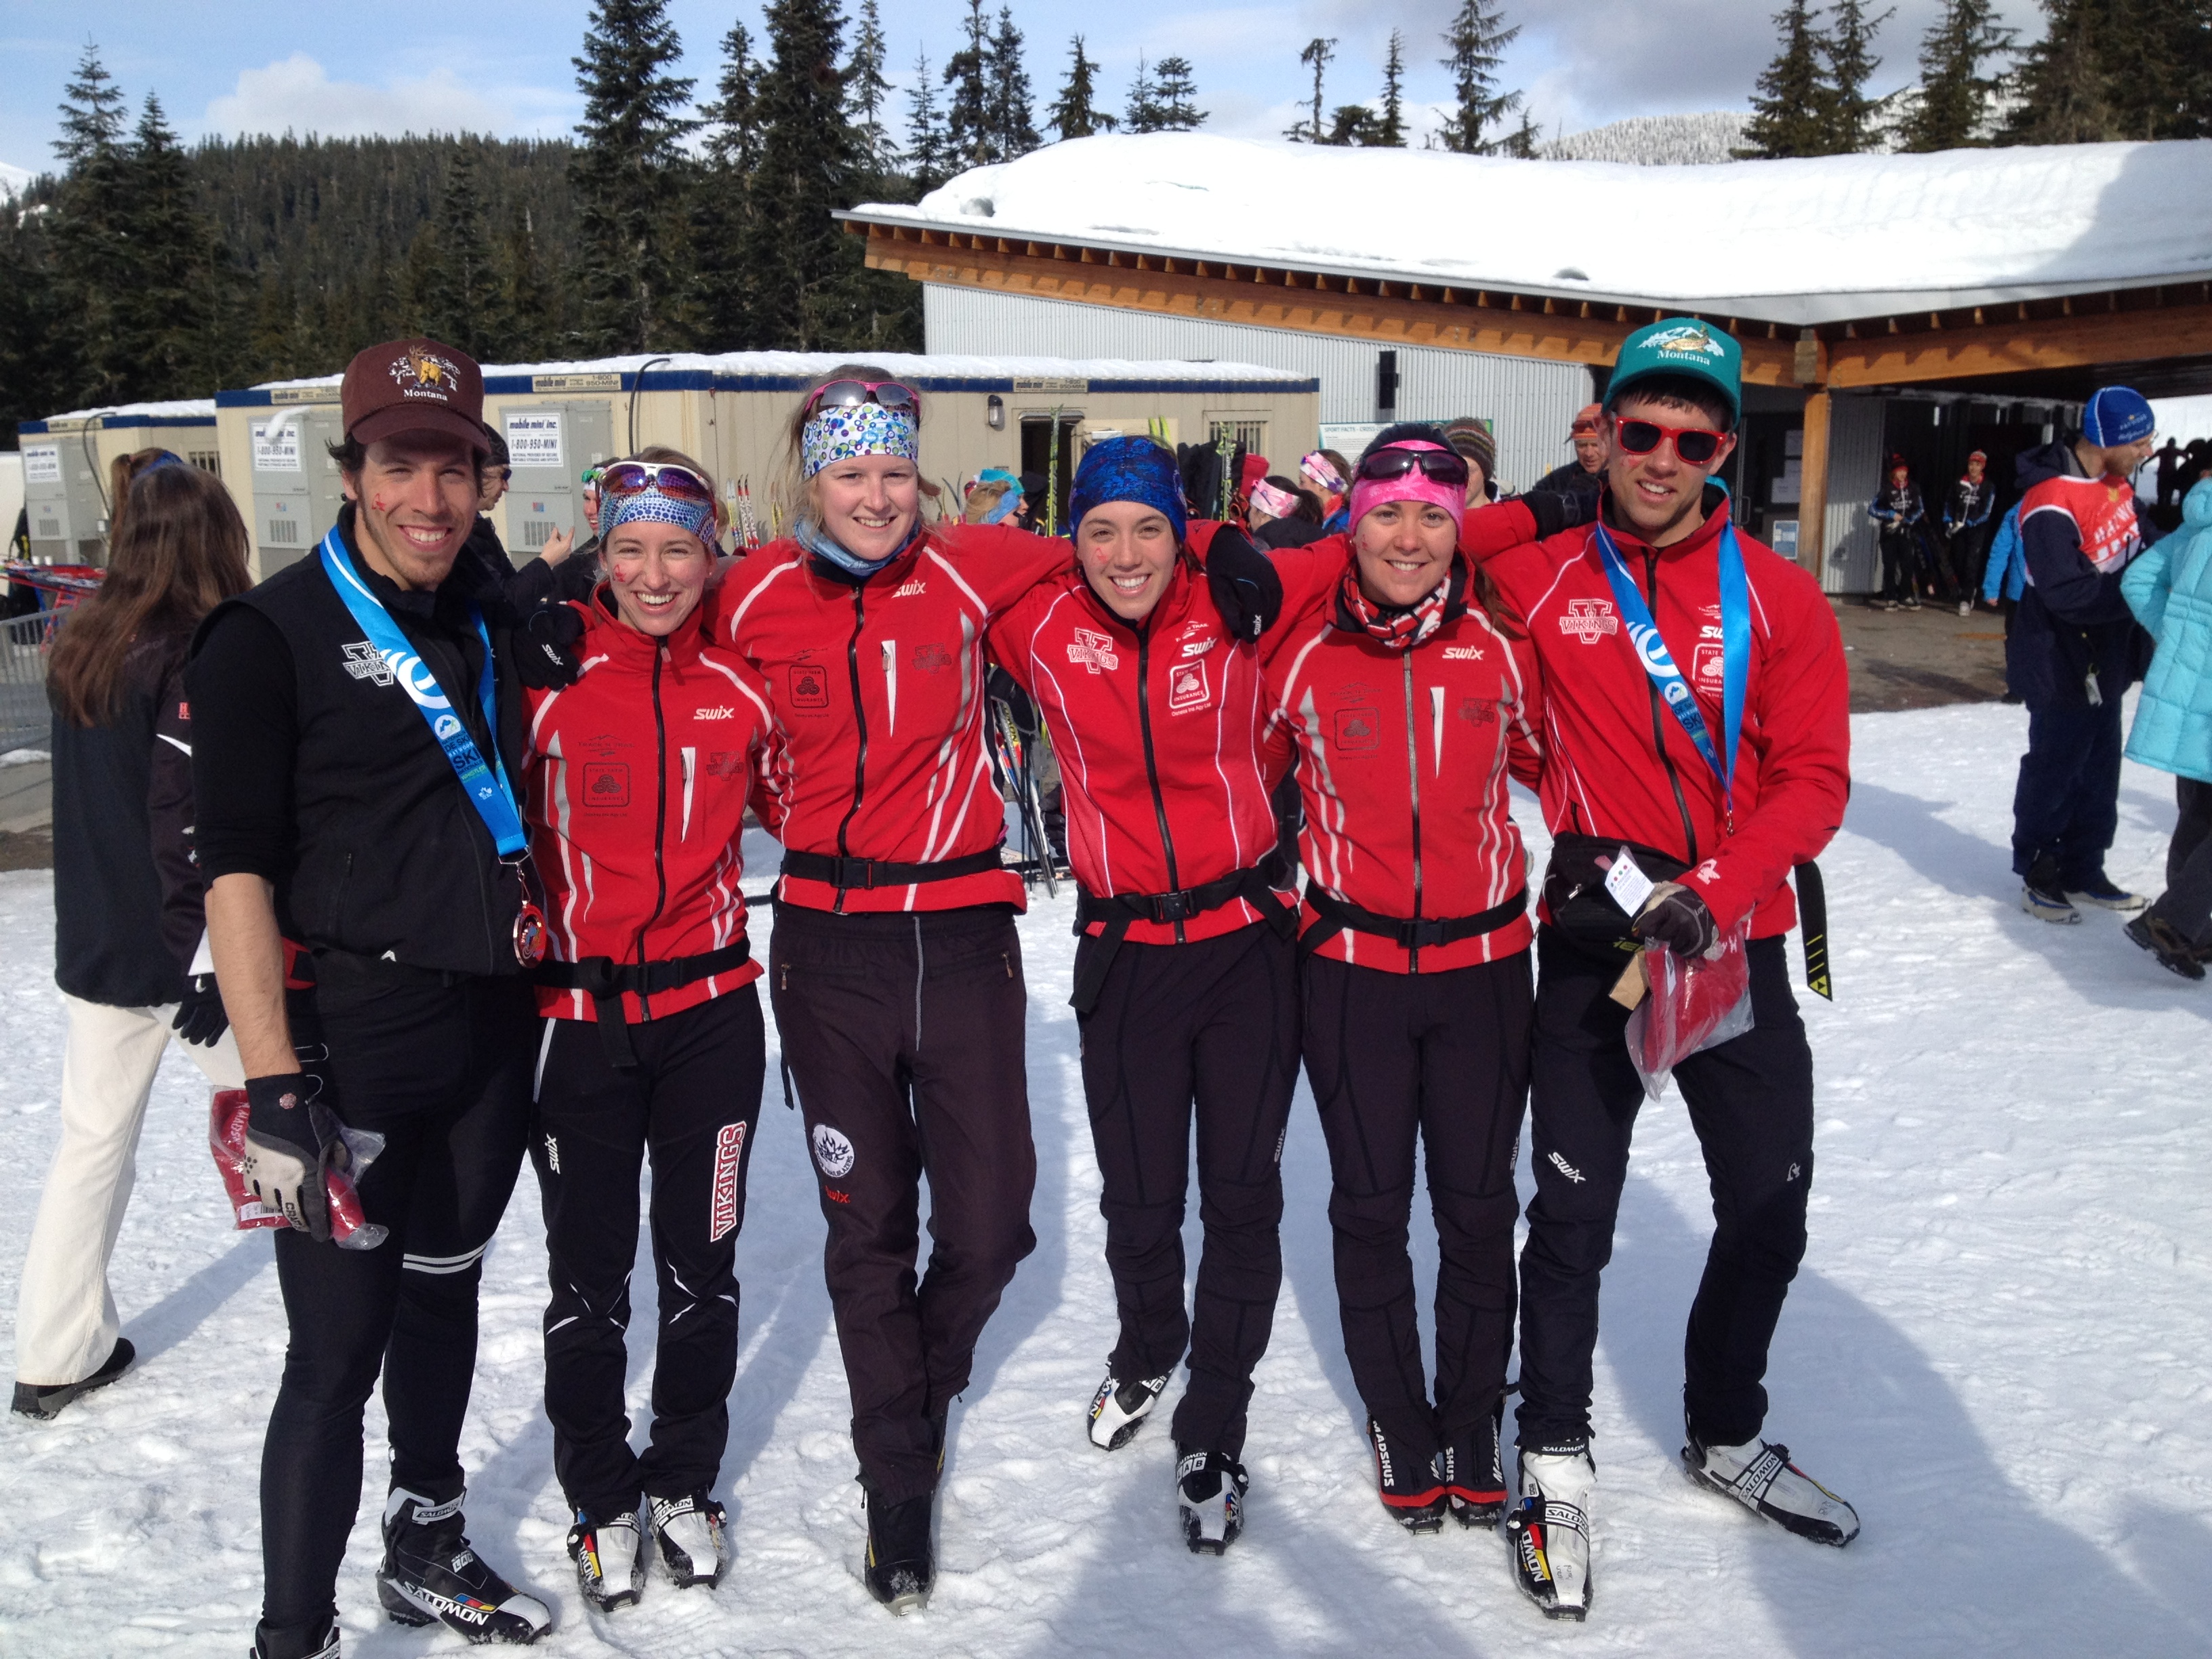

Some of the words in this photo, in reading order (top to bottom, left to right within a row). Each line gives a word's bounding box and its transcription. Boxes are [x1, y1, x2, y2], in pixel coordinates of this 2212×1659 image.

[1656, 350, 1711, 366] Montana
[403, 389, 448, 402] Montana
[511, 438, 558, 450] 1-800-950-MINI
[1561, 617, 1618, 634] VIKINGS
[346, 659, 392, 678] VIKIN
[1069, 645, 1118, 670] VIKINGS
[445, 741, 456, 752] DE
[452, 747, 482, 770] SKI
[824, 1155, 853, 1176] TRAILBLAZERS
[713, 1123, 745, 1240] VIKINGS
[1372, 1420, 1395, 1487] MADSHUS
[1541, 1443, 1585, 1453] SALOMON
[1446, 1446, 1454, 1482] SHUS
[1740, 1456, 1778, 1501] SALOMON
[653, 1499, 692, 1522] ALOMON
[1547, 1508, 1589, 1532] SALOM
[452, 1553, 474, 1574] LAB
[1521, 1530, 1547, 1582] OMON
[401, 1580, 490, 1626] SALOMON
